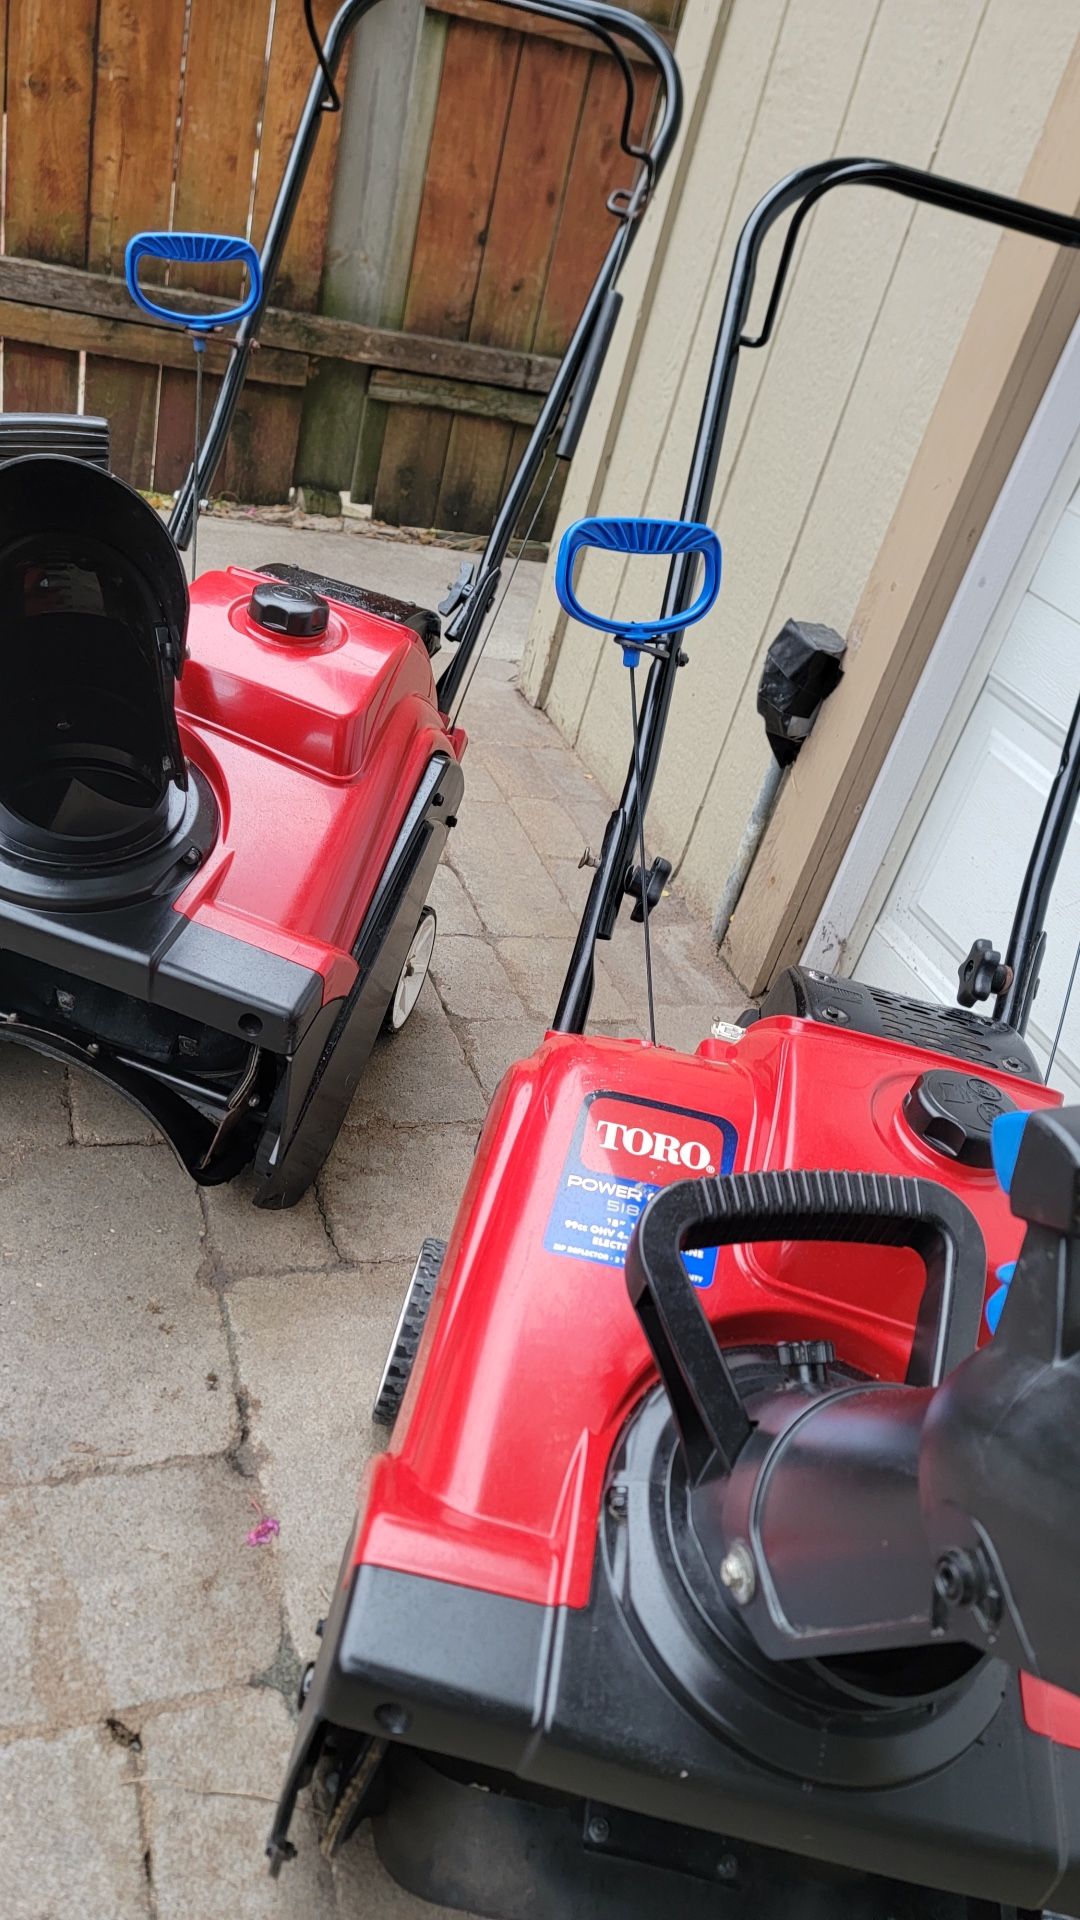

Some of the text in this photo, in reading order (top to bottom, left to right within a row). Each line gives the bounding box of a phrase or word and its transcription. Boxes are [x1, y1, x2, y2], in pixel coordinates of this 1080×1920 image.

[596, 1120, 711, 1171] TORO
[567, 1174, 643, 1202] POWER
[606, 1199, 640, 1216] 518
[590, 1225, 615, 1237] OHV
[593, 1236, 628, 1251] ELECTR
